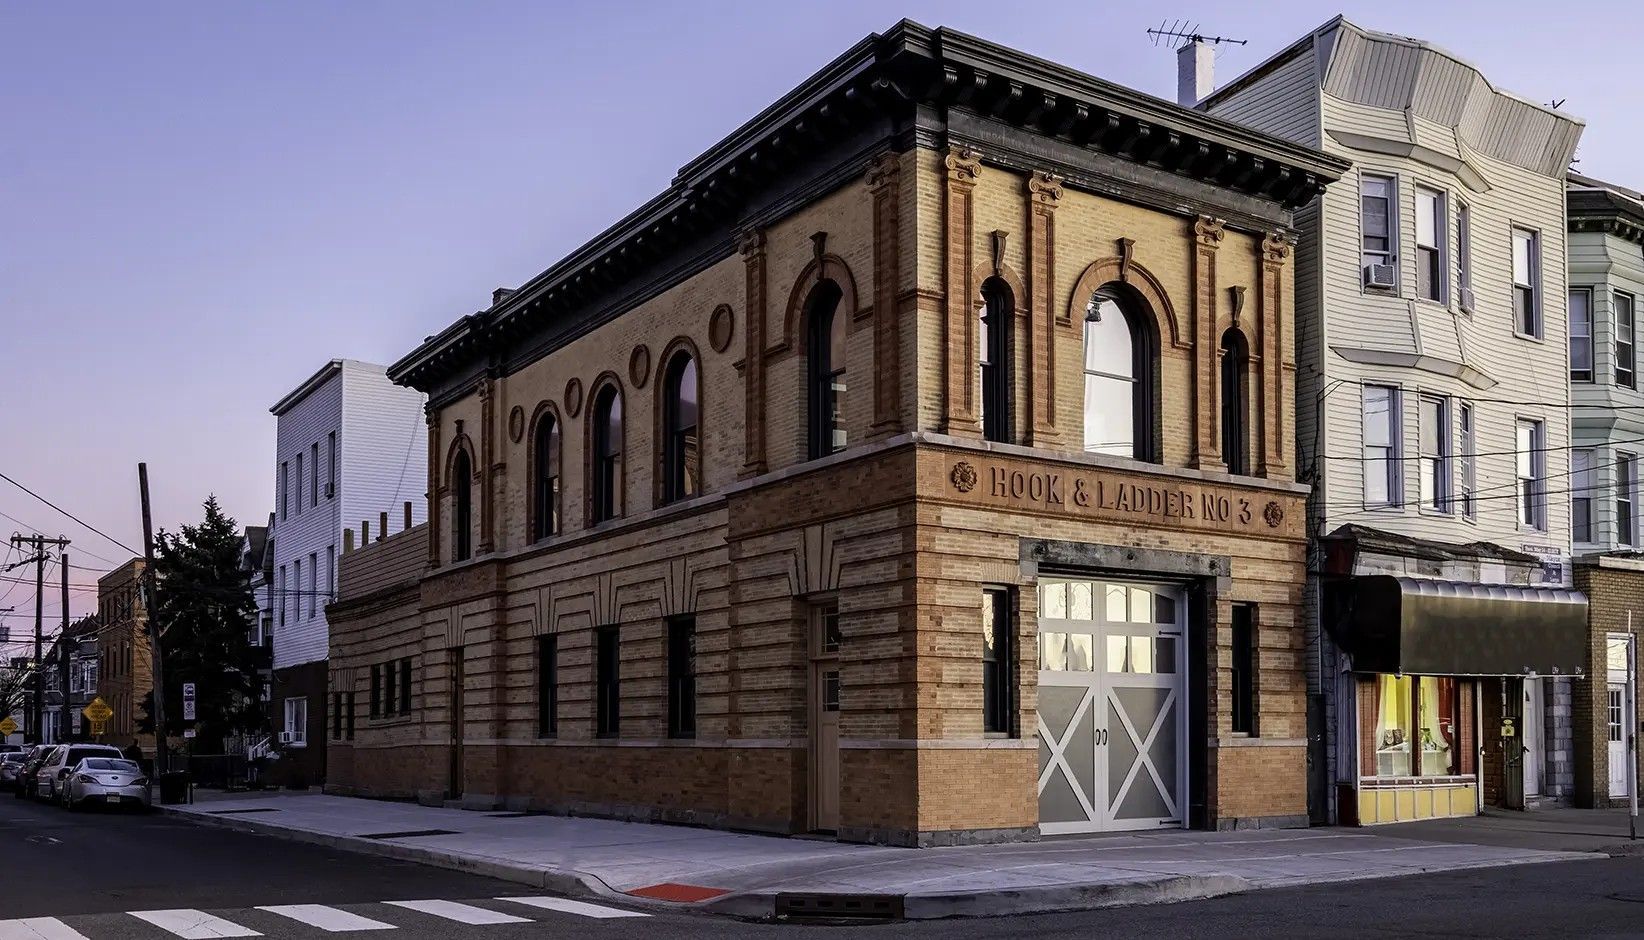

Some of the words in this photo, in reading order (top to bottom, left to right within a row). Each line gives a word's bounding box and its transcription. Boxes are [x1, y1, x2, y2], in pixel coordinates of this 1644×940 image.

[989, 466, 1064, 505] HOOK
[1074, 478, 1090, 508] &
[1098, 481, 1196, 519] LADDER
[1202, 492, 1230, 523] NO
[1238, 497, 1252, 525] 3
